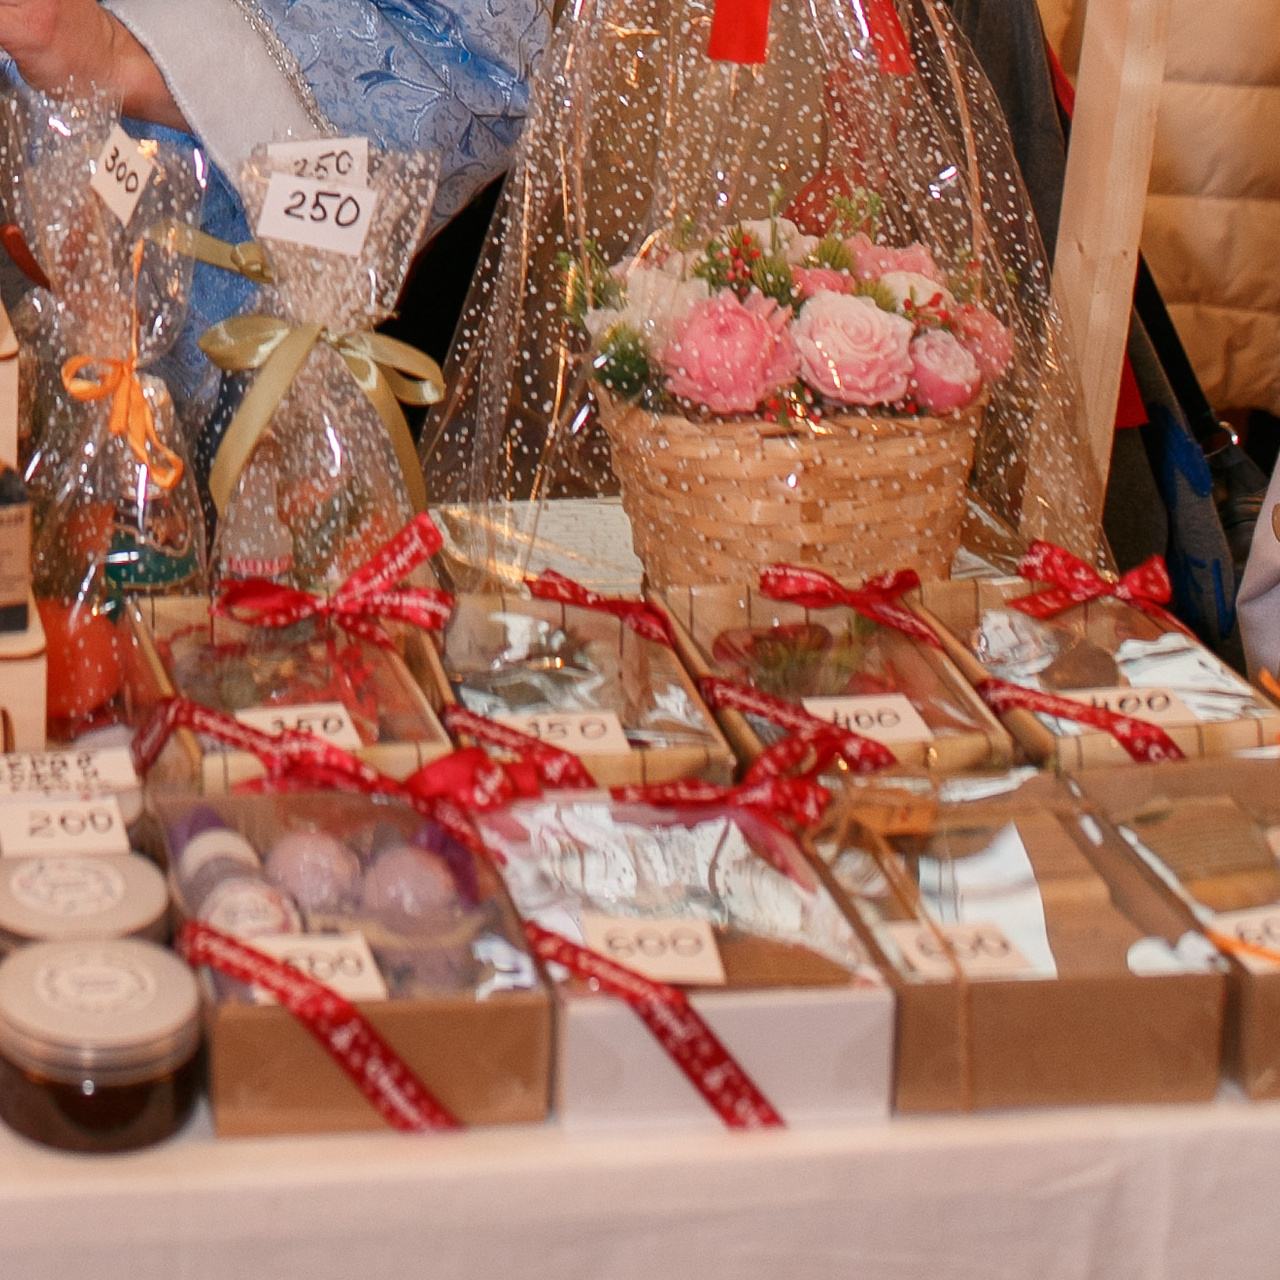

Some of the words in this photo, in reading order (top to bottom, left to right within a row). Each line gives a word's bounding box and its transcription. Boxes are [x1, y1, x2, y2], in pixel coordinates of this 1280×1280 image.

[103, 146, 140, 194] 300
[283, 190, 361, 227] 250
[28, 807, 114, 839] 200
